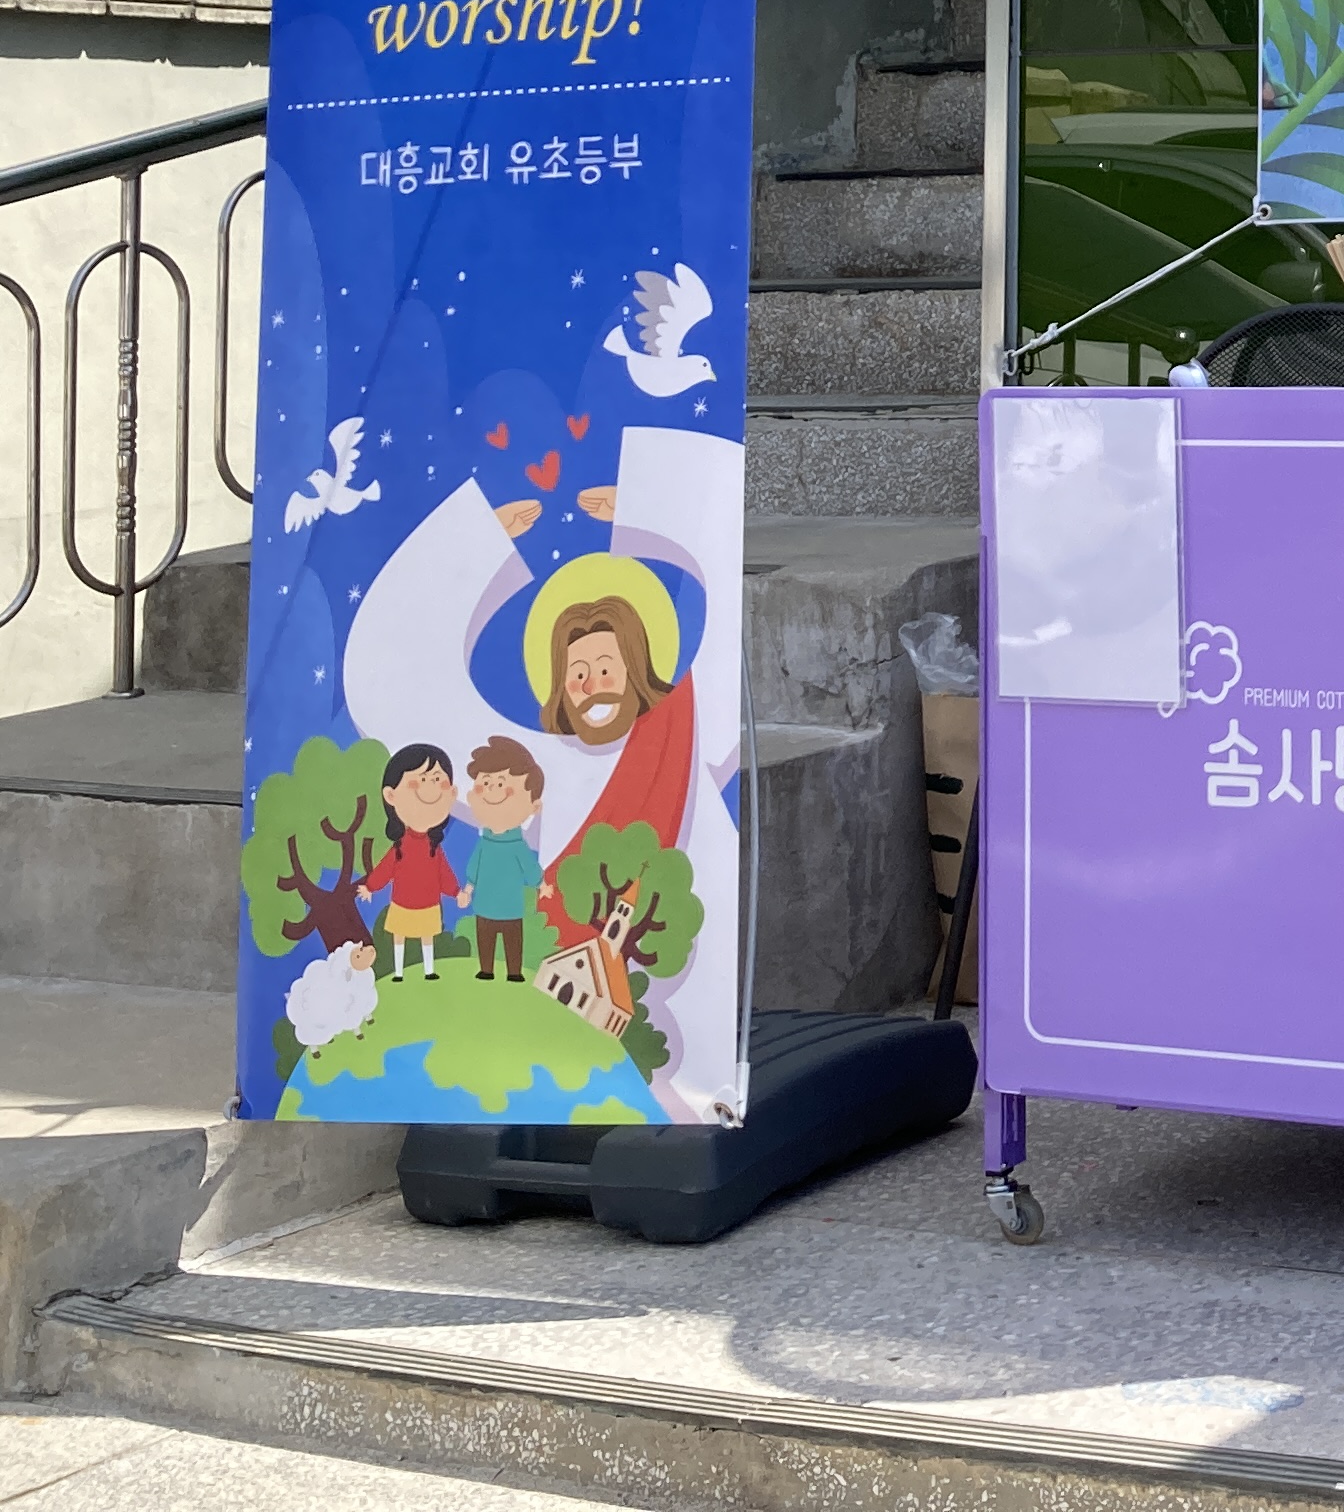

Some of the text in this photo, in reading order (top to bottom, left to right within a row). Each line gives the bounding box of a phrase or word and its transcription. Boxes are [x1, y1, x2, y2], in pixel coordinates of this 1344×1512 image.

[360, 133, 643, 195] 대흥교회 유초등부
[1244, 688, 1310, 709] PREMIUM
